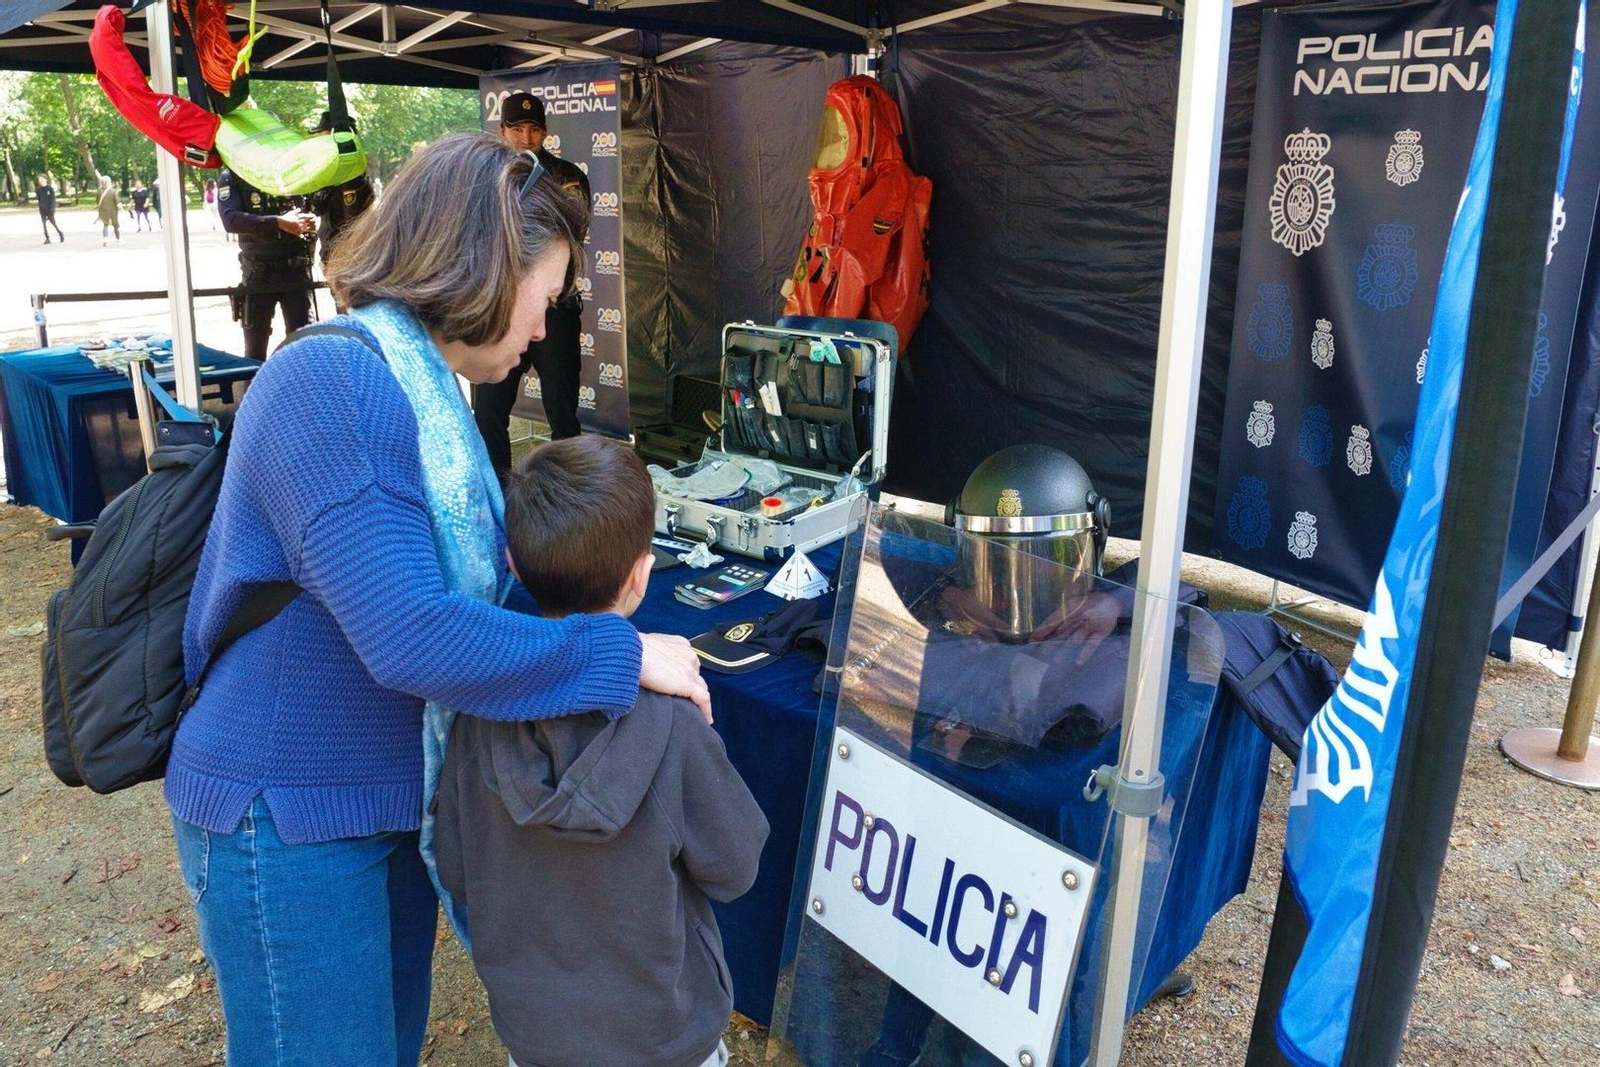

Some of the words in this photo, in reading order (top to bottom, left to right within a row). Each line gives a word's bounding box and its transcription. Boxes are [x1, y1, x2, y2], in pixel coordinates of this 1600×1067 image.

[1293, 62, 1490, 96] NACION
[543, 97, 617, 116] ACIONAL
[591, 132, 617, 148] 200
[593, 192, 618, 208] 200
[595, 250, 620, 266] 200
[576, 277, 592, 292] 00
[597, 307, 622, 324] 200
[579, 332, 595, 348] 00
[599, 362, 623, 379] 200
[578, 386, 596, 401] 00
[824, 789, 1048, 1015] POLICIA
